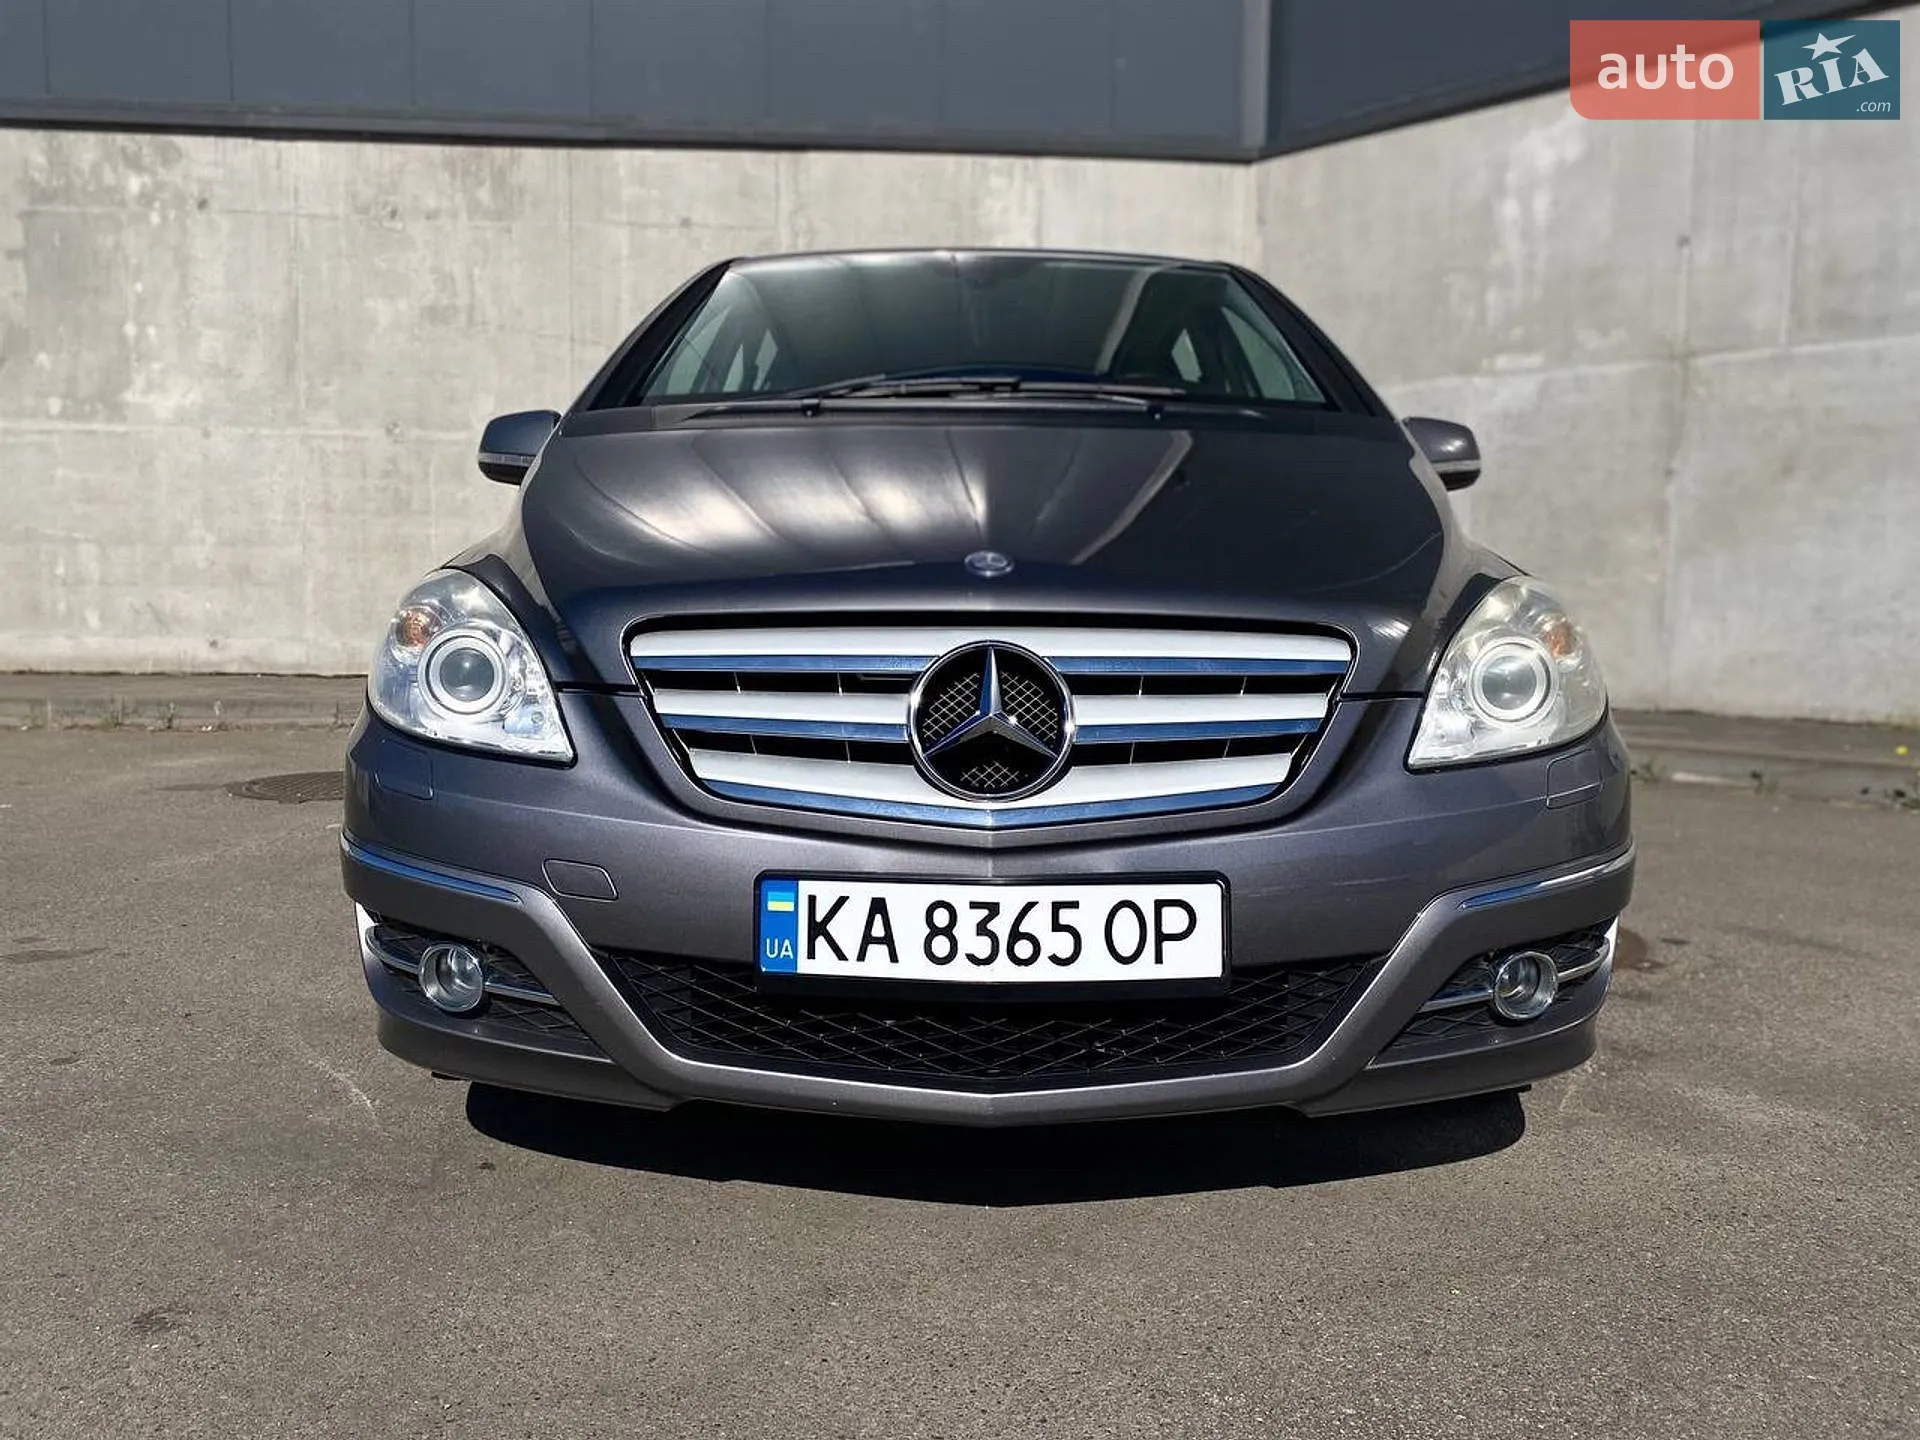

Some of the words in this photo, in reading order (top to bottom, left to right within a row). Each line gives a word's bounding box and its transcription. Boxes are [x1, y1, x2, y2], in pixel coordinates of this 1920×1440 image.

[766, 938, 794, 959] UA
[806, 894, 899, 963] KA
[923, 899, 1083, 967] 8365
[1104, 898, 1197, 965] OP
